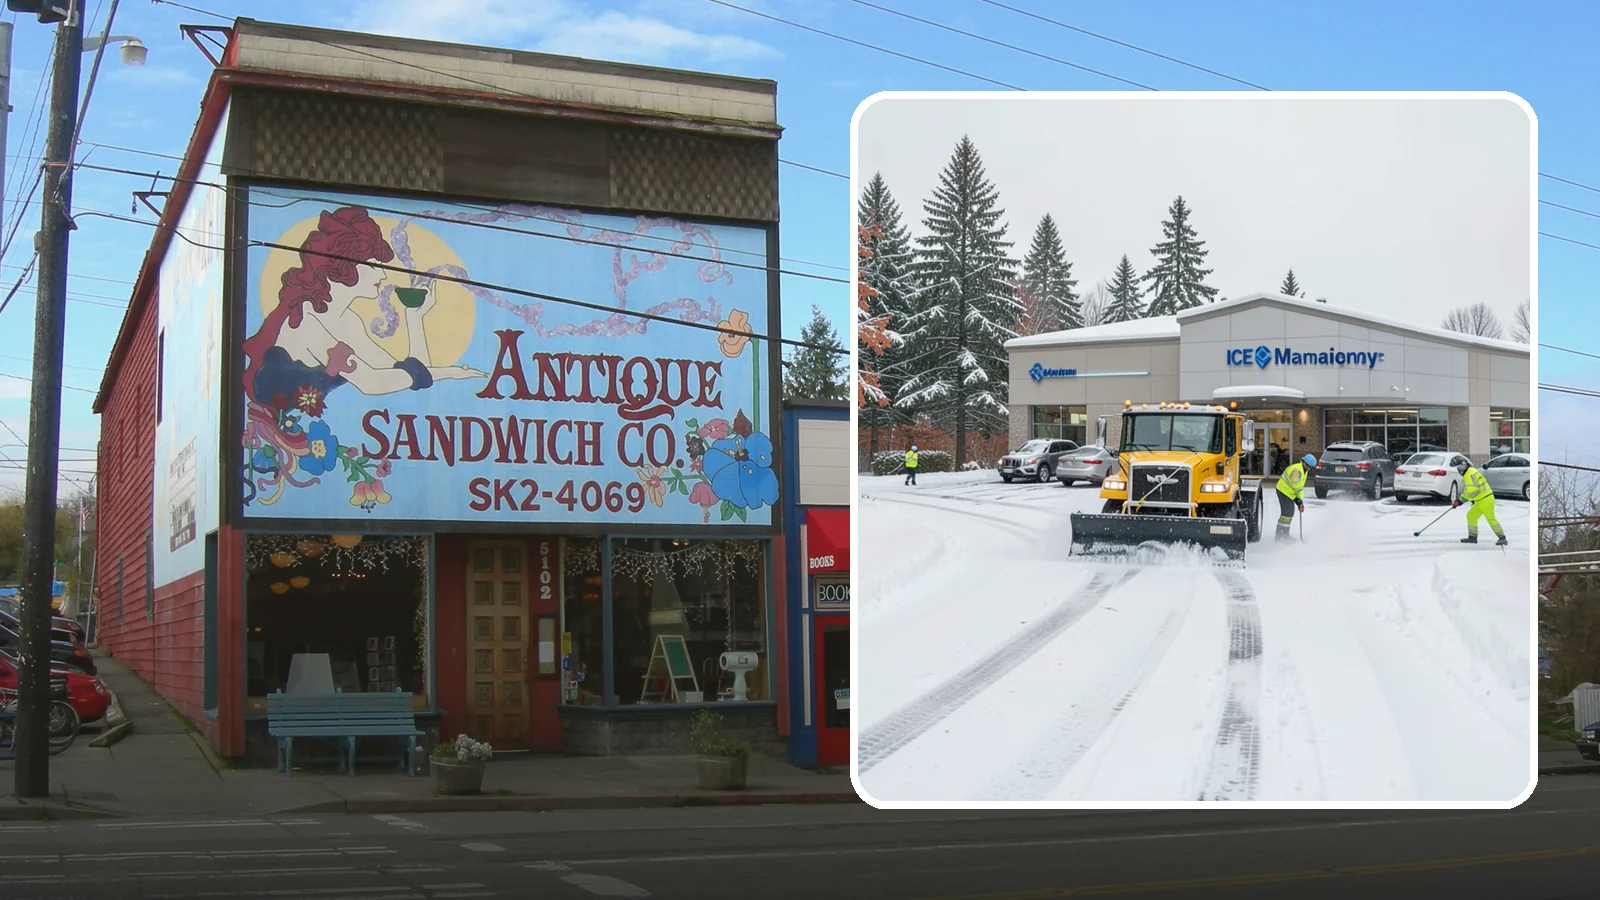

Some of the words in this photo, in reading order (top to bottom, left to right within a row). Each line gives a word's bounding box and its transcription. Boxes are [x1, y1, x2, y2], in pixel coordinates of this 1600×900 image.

[476, 329, 723, 420] ANTIQUE
[1226, 348, 1253, 366] ICE
[361, 408, 604, 467] SANDWICH
[617, 422, 685, 470] CO.
[468, 477, 646, 513] SK2-4069
[809, 555, 834, 569] BOOKS
